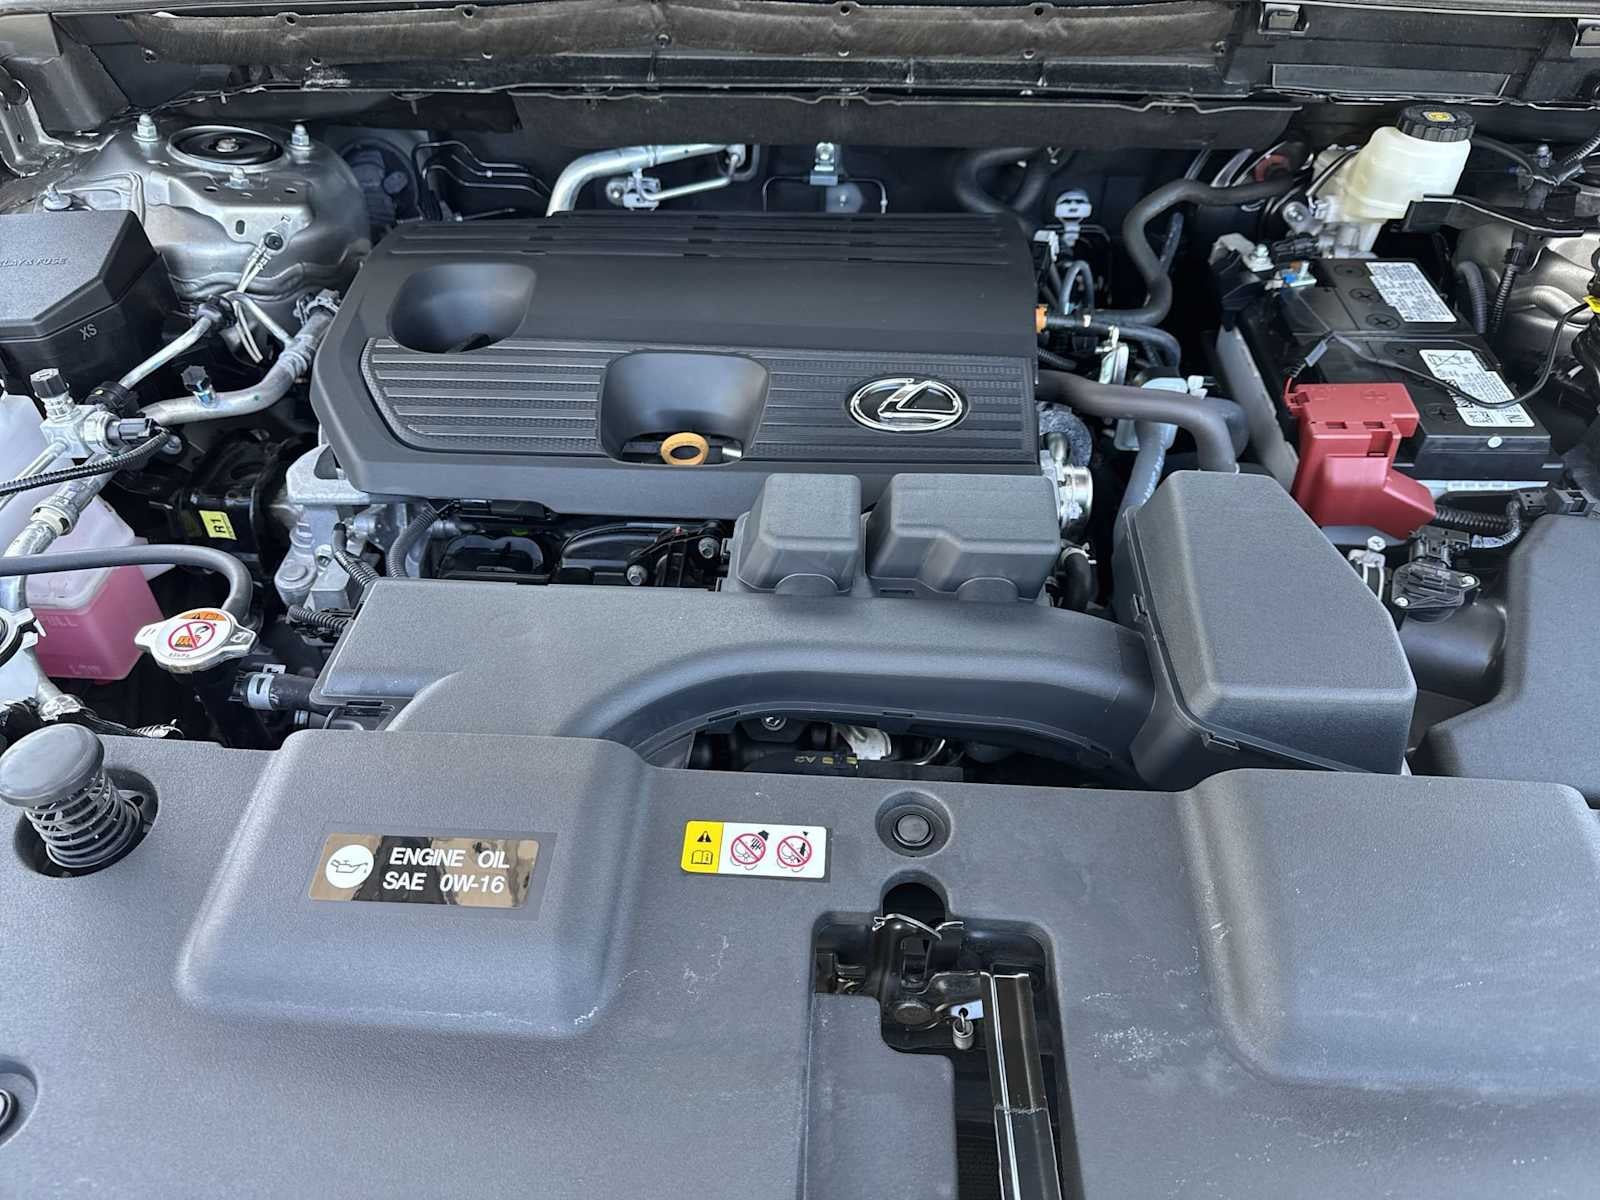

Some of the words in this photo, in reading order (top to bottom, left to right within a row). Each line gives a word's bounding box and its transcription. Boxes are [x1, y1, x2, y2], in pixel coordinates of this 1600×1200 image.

[389, 847, 466, 867] ENGINE
[477, 850, 510, 869] OIL
[382, 871, 427, 891] SAE
[440, 873, 506, 893] 0W-16
